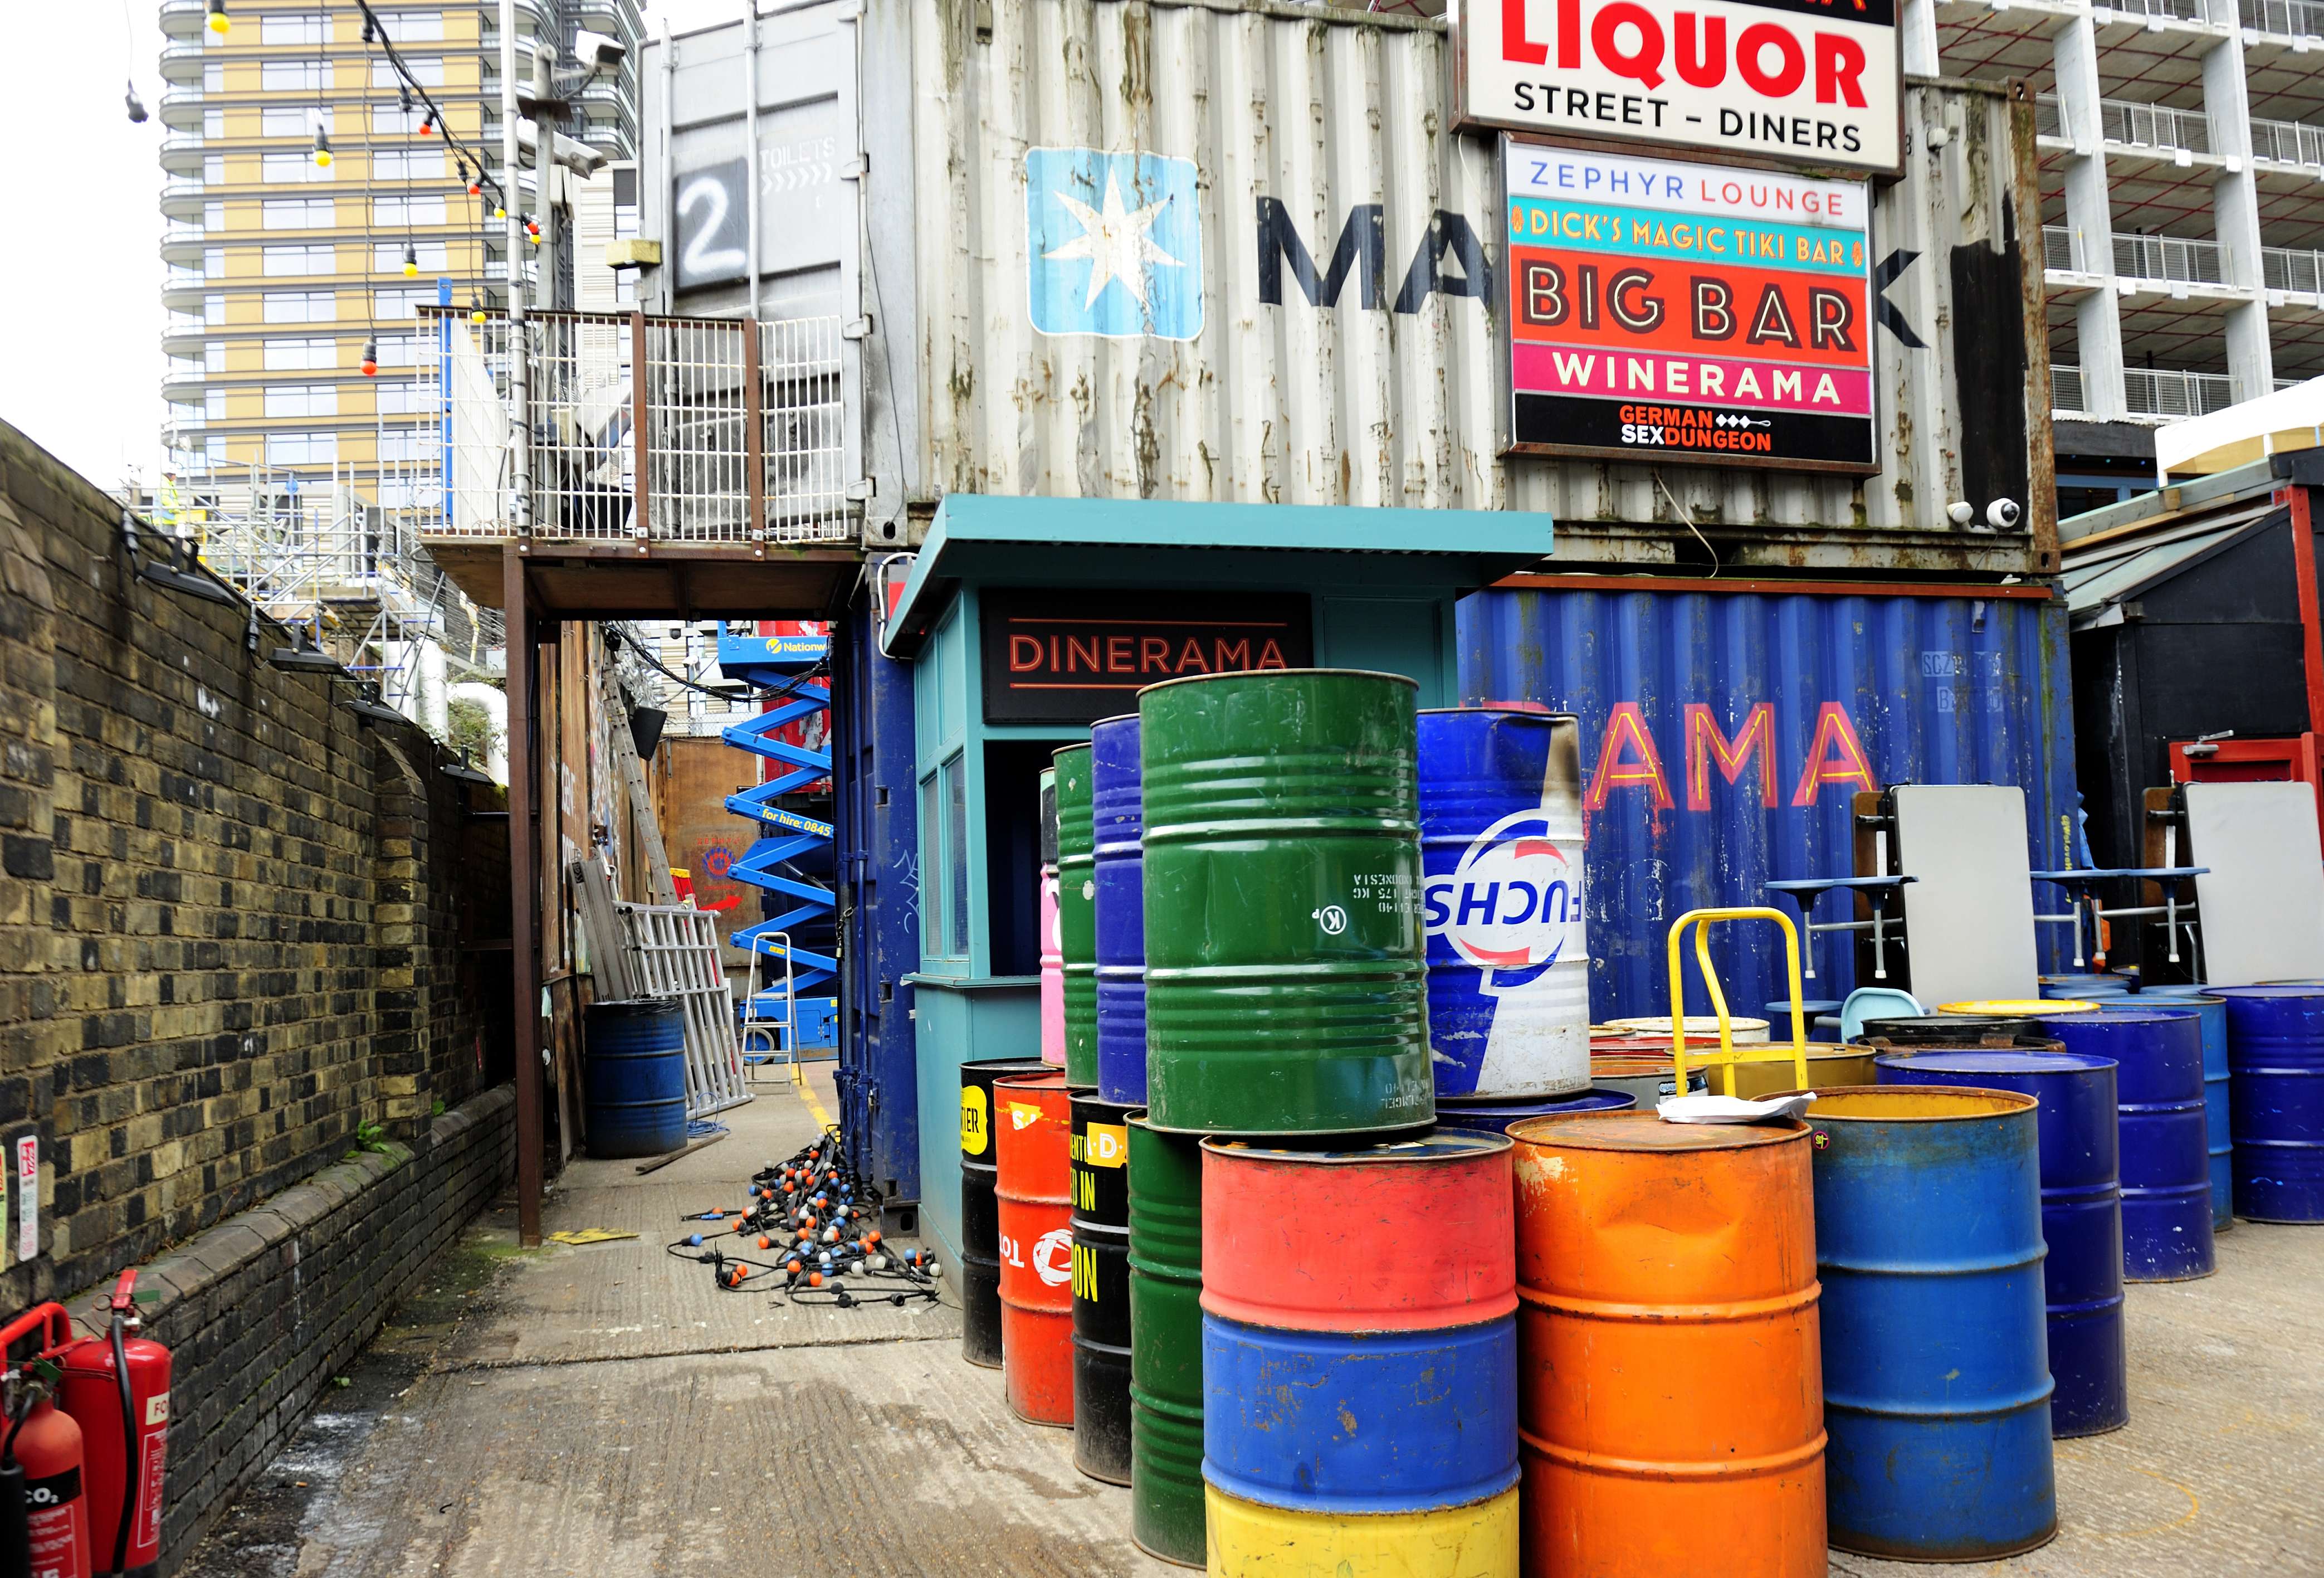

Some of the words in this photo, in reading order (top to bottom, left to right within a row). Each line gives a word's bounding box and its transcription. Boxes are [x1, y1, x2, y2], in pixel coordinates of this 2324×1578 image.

[1502, 0, 1868, 109] LIQUOR
[1514, 81, 1669, 128] STREET
[1720, 108, 1861, 153] DINERS
[759, 137, 836, 170] TOILETS
[1530, 160, 1685, 199] ZEPHYR
[1701, 179, 1843, 216] LOUNGE
[677, 177, 746, 275] 2
[1530, 209, 1622, 241] DICK'S
[1632, 218, 1726, 252] MAGIC
[1734, 229, 1784, 259] TIKI
[1796, 236, 1846, 265] BAR
[1520, 259, 1665, 334] BIG
[1691, 275, 1857, 352] BAR
[1552, 352, 1841, 405] WINERAMA
[1619, 405, 1713, 428] GERMAN
[1009, 634, 1287, 673] DINERAMA
[762, 808, 778, 821] for
[779, 812, 803, 829] hire:
[804, 820, 831, 836] 0845
[1353, 888, 1370, 898] KG
[1354, 874, 1413, 885] INDONESIA
[1378, 888, 1397, 899] 175
[1425, 880, 1582, 927] FUCHS
[1080, 1170, 1096, 1211] IN
